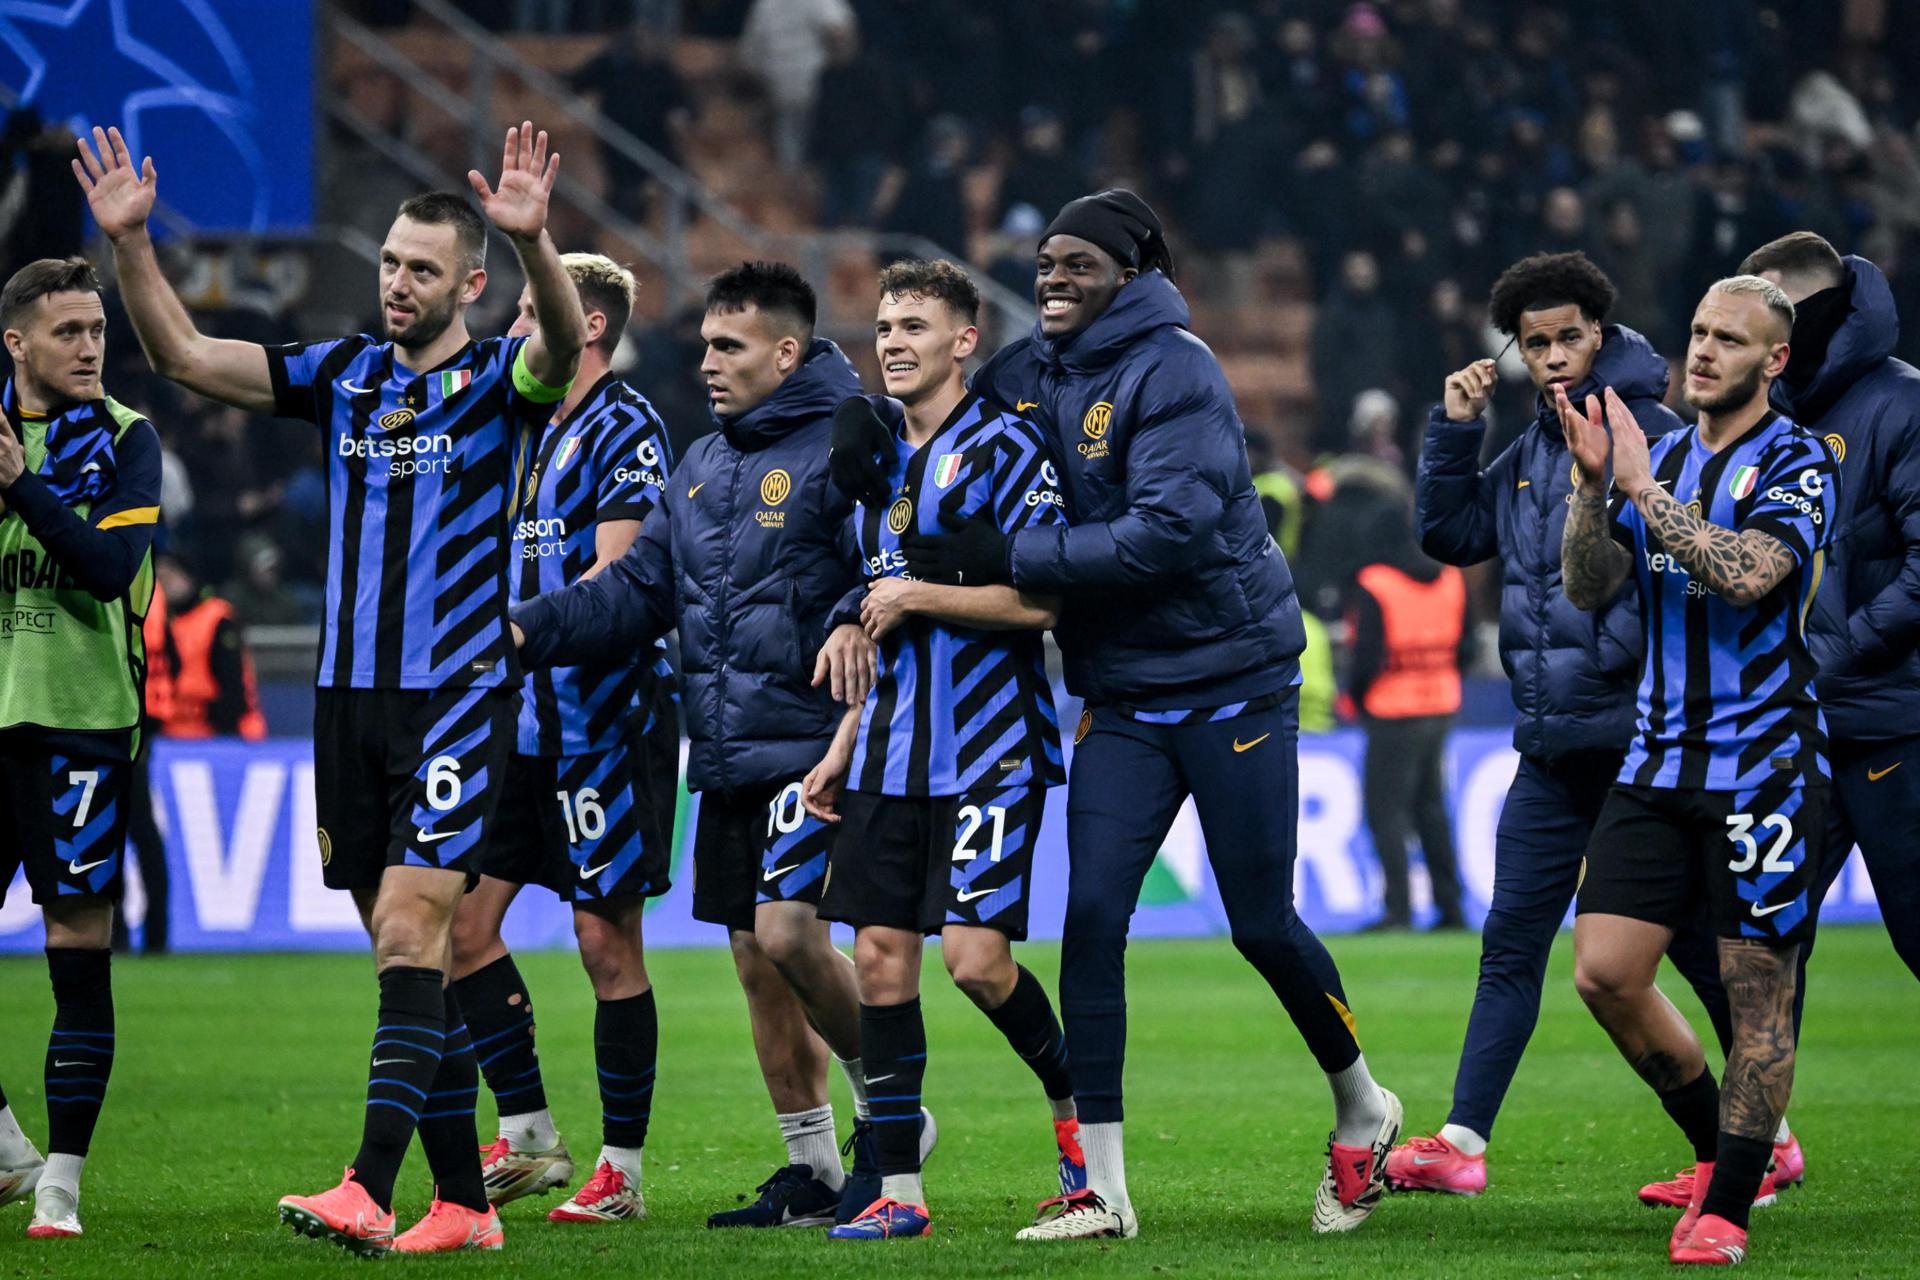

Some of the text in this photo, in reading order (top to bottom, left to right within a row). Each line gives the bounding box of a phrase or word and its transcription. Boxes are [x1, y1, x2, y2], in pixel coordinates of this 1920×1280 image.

[338, 432, 453, 458] betsson
[1077, 440, 1108, 456] QATAR
[384, 455, 452, 478] .sport
[614, 467, 666, 492] Gate.io
[1024, 490, 1065, 508] Gate.
[755, 511, 785, 523] QATAR
[519, 539, 567, 562] .sport
[425, 755, 461, 811] 6
[68, 770, 99, 827] 7
[557, 786, 607, 843] 16
[951, 805, 1006, 862] 21
[1725, 813, 1795, 874] 32
